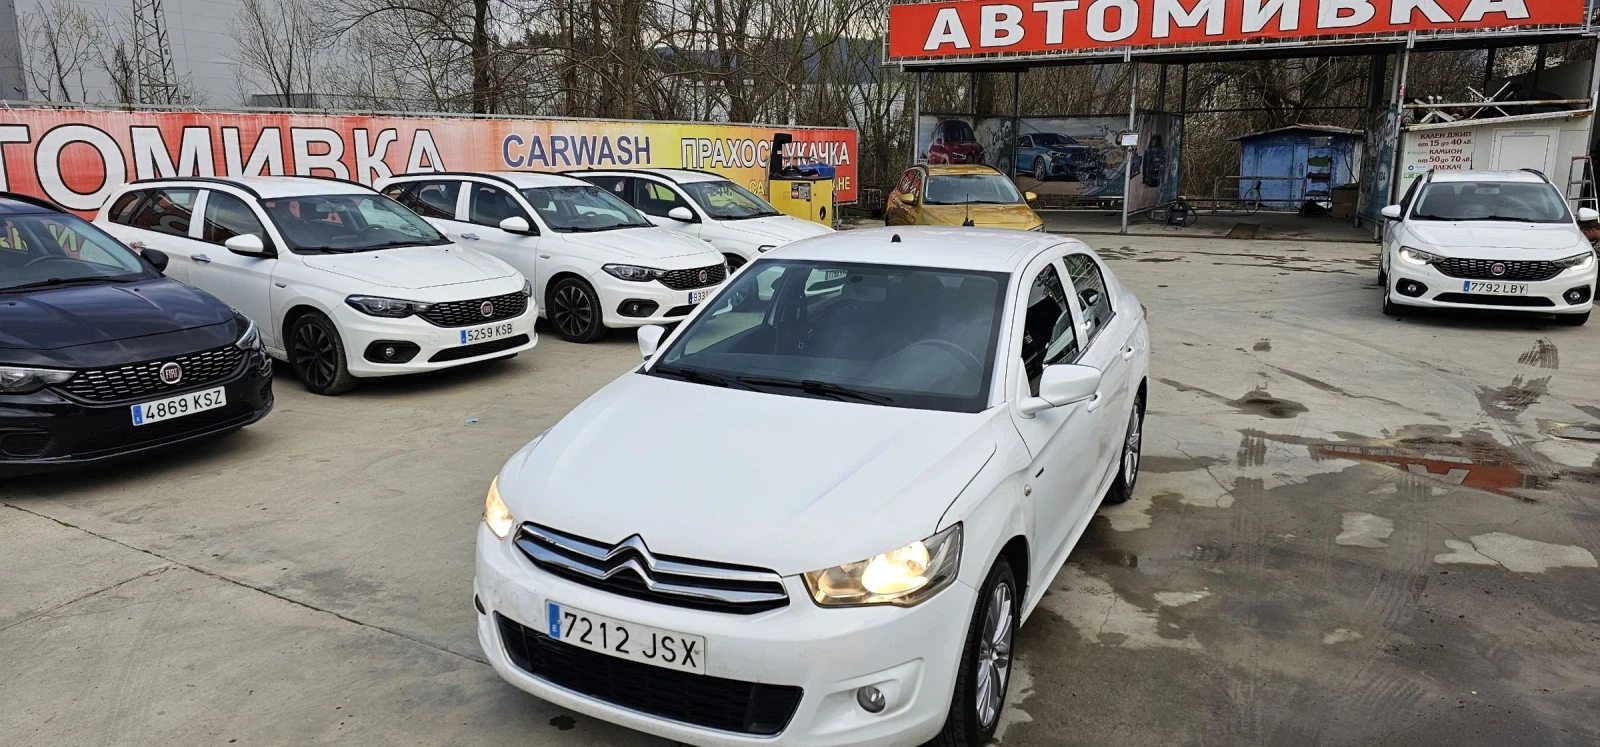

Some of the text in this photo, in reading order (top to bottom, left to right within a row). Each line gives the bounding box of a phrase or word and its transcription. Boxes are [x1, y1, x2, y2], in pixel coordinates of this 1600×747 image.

[502, 133, 651, 168] CARWASH
[1471, 282, 1525, 294] 7792 LBY
[467, 323, 513, 341] 5259 KSB
[165, 368, 178, 379] FIAT
[145, 398, 188, 420] 4869
[193, 390, 222, 410] KSZ
[564, 611, 629, 654] 7212
[642, 633, 697, 668] JSX
